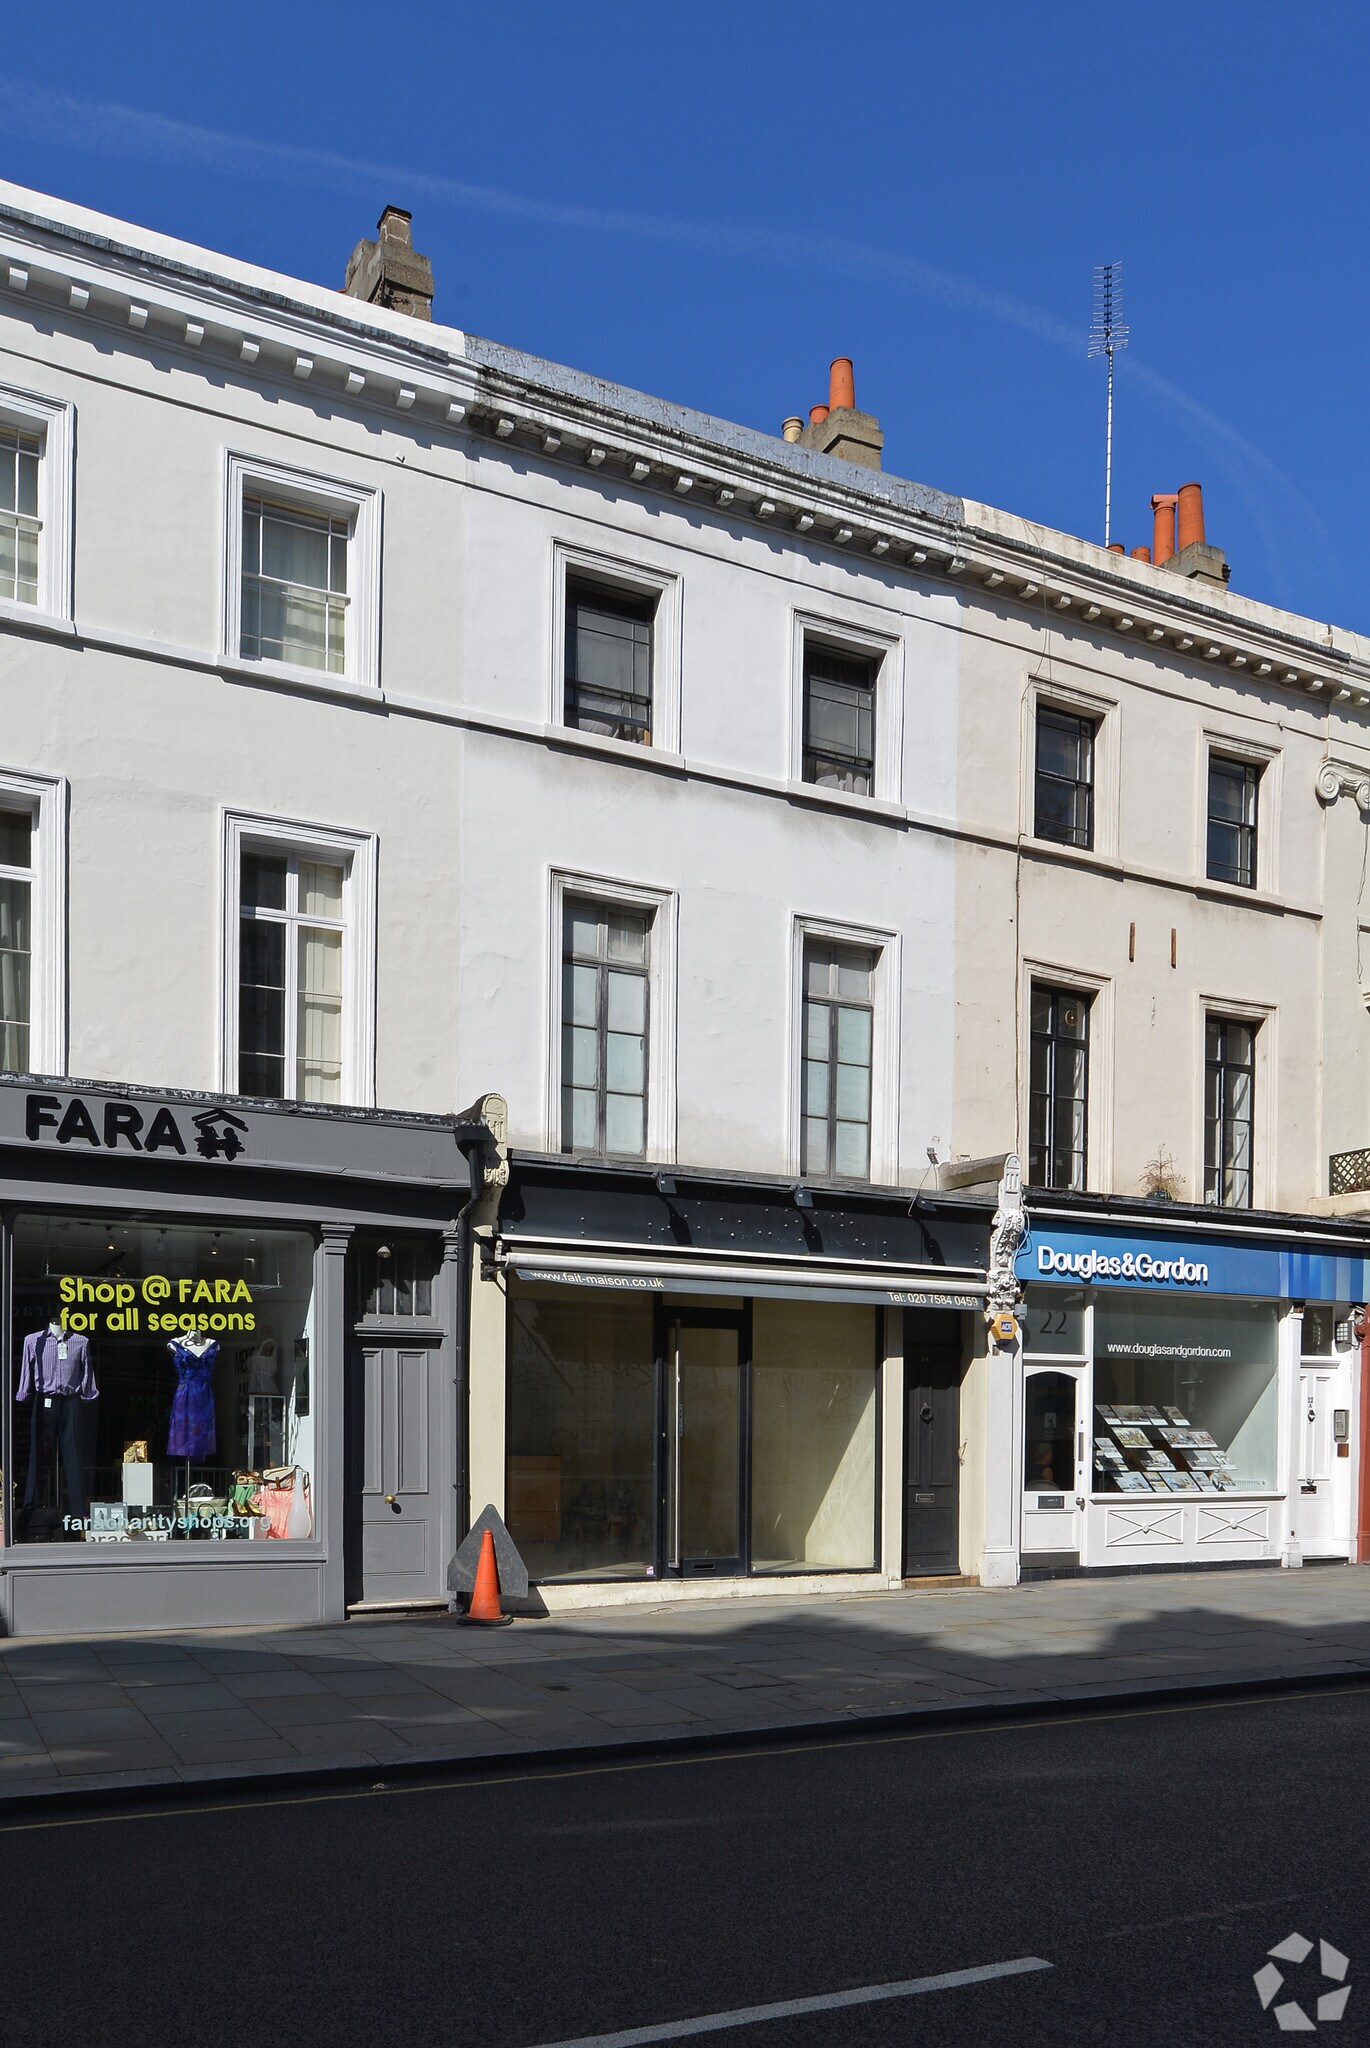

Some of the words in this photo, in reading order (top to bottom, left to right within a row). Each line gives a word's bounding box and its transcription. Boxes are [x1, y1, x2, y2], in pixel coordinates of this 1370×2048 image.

[26, 1094, 187, 1155] FARA
[1038, 1245, 1208, 1282] Douglas&Gordon
[59, 1277, 135, 1307] Shop
[142, 1275, 171, 1305] @
[179, 1279, 253, 1303] FARA
[530, 1271, 665, 1288] www.fait-maison.co.uk
[887, 1292, 906, 1303] Tel:
[907, 1293, 927, 1304] 020
[929, 1294, 953, 1305] 7584
[954, 1296, 978, 1307] 0459
[60, 1307, 97, 1331] for
[106, 1308, 139, 1331] all
[148, 1312, 256, 1331] seasons
[1039, 1311, 1068, 1334] 22
[1107, 1342, 1231, 1358] www.douglasandgordon.com
[63, 1514, 271, 1533] faracharityshops.org
